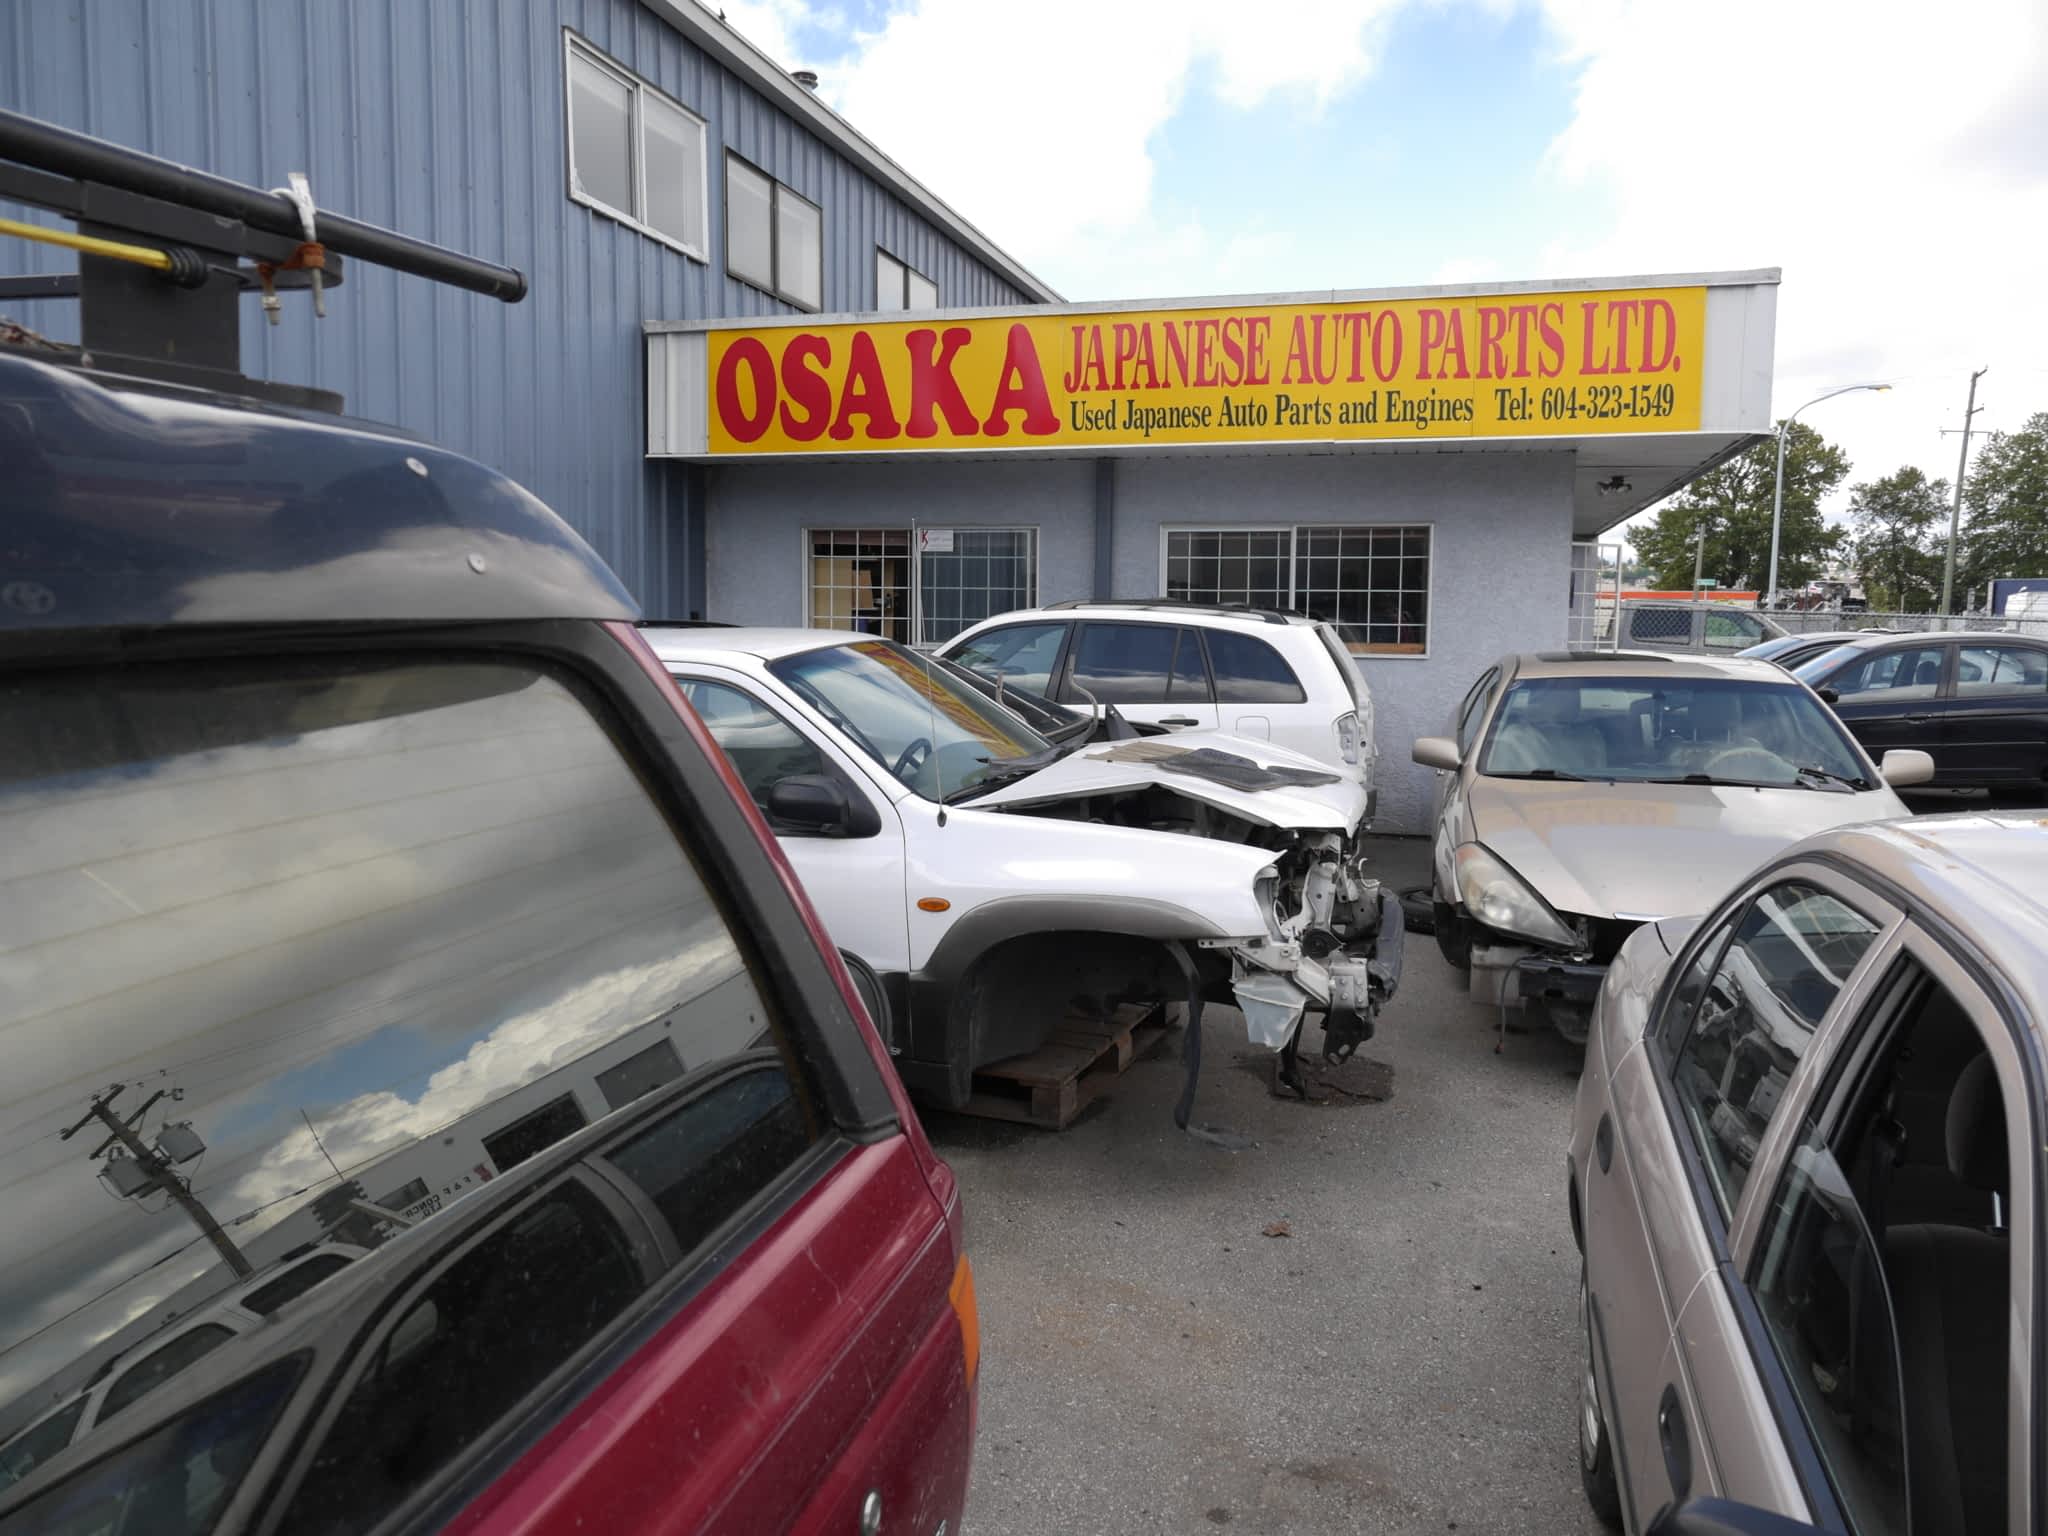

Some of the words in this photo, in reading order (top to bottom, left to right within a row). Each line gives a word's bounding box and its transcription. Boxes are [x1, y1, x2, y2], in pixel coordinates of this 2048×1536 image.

[716, 323, 1061, 443] OSAKA
[1064, 315, 1271, 394] JAPANESE
[1281, 309, 1403, 386] AUTO
[1415, 302, 1565, 380] PARTS
[1578, 298, 1681, 376] LTD.
[1070, 399, 1116, 432] Used
[1122, 399, 1212, 437] Japanese
[1217, 395, 1267, 427] Auto
[1274, 394, 1332, 425] Parts
[1338, 390, 1378, 424] and
[1385, 388, 1474, 430] Engines
[1494, 386, 1533, 421] Tel:
[1541, 383, 1674, 420] 604-323-1549
